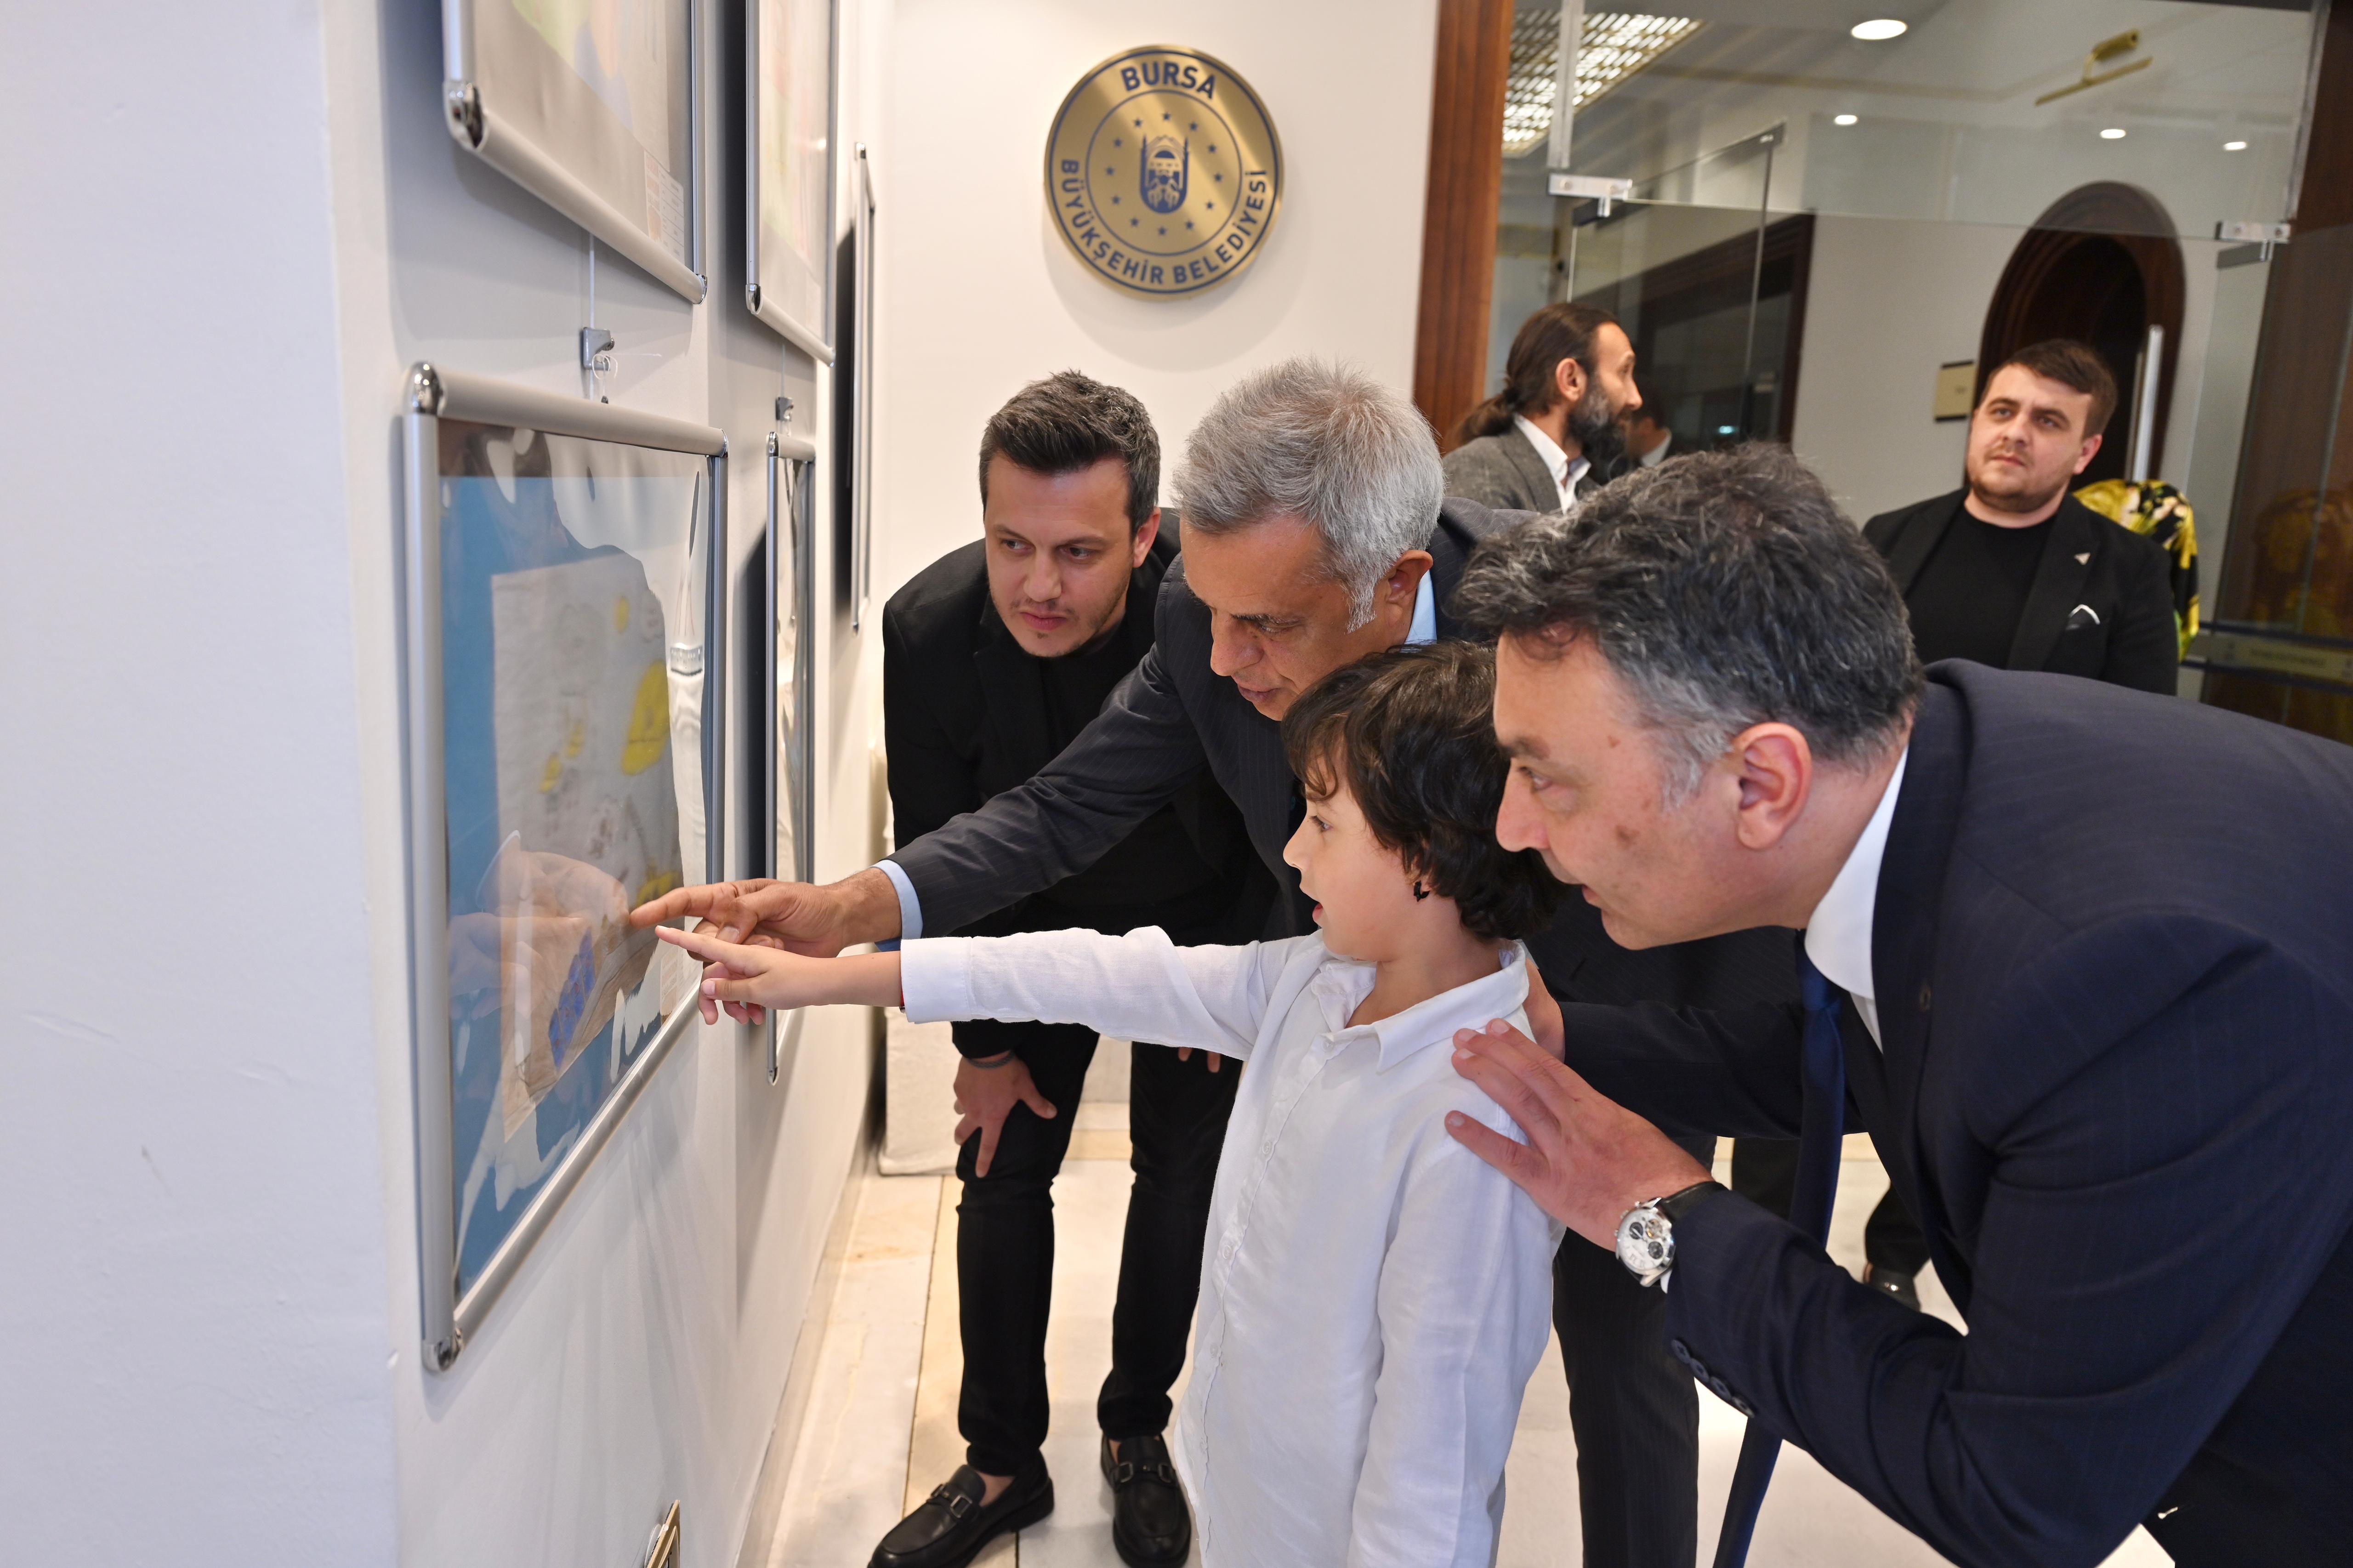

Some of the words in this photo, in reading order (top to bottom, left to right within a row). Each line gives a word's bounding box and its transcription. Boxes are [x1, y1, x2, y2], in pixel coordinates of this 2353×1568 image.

[1120, 61, 1216, 99] BURSA
[1061, 159, 1164, 284] BÜYÜKŞEHİR
[1173, 170, 1267, 284] BELEDİYESİ
